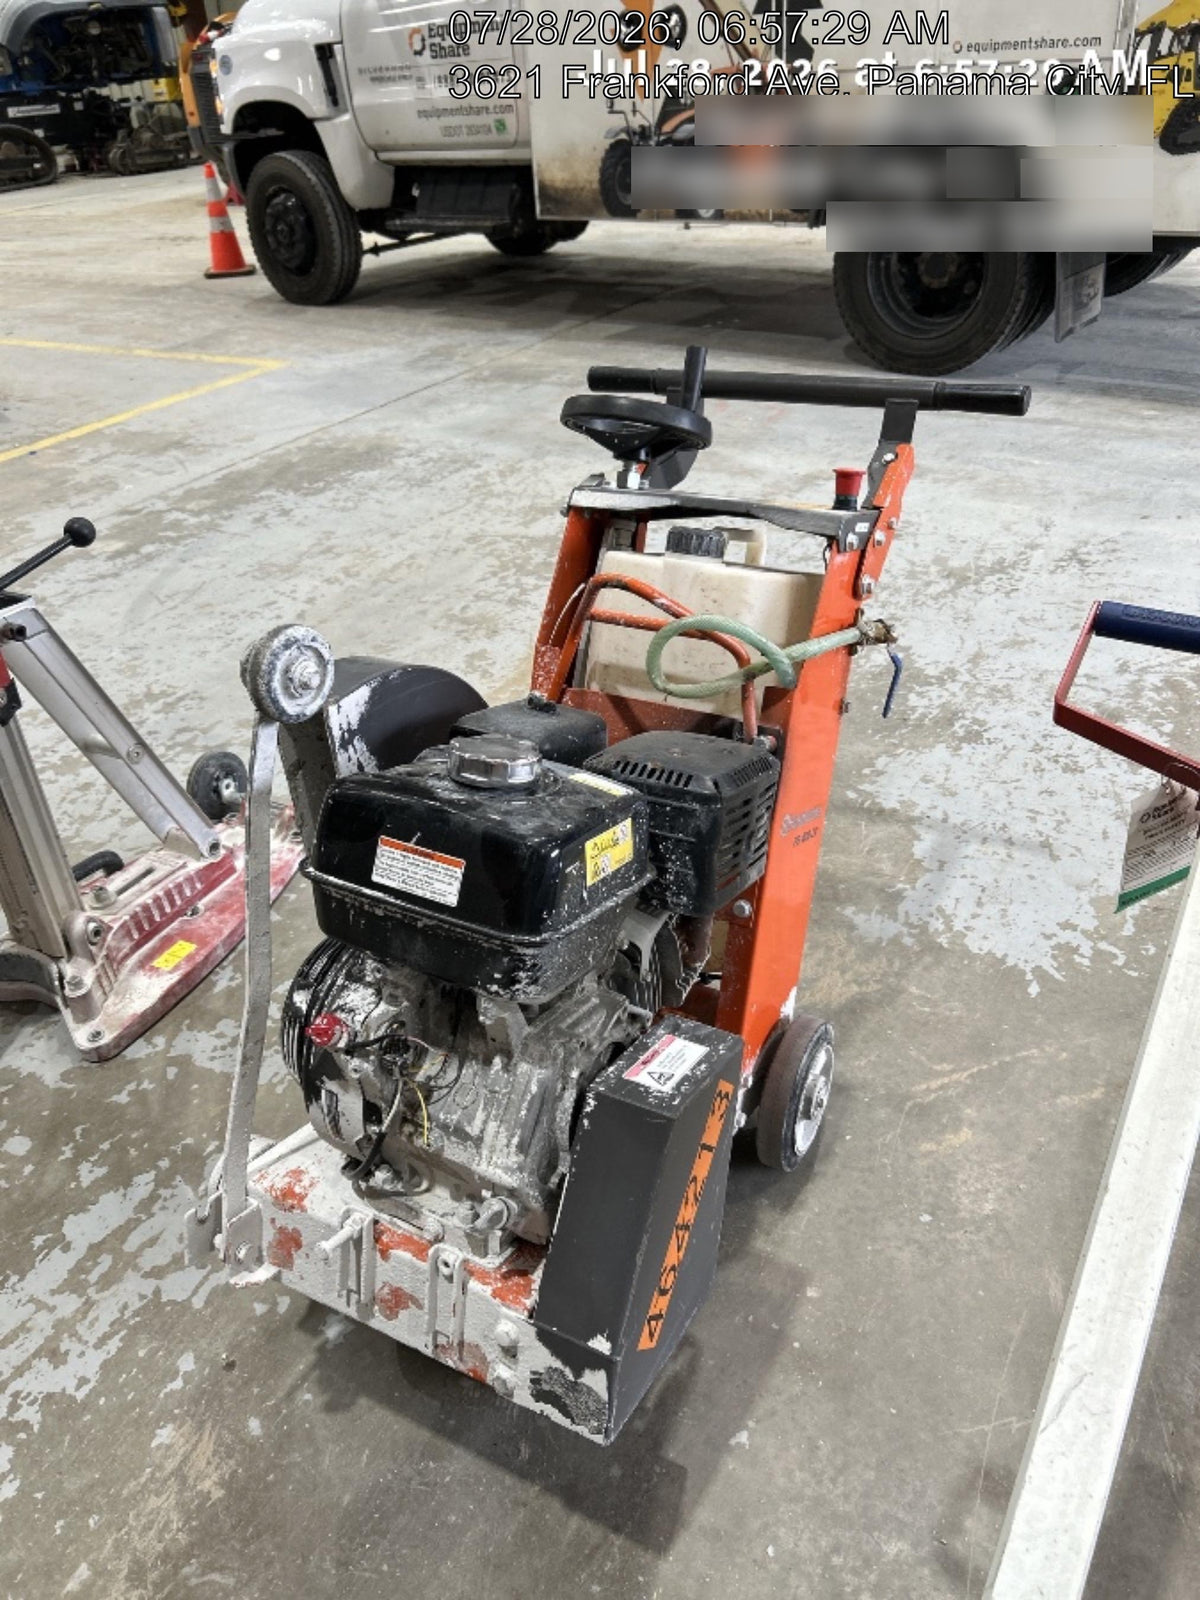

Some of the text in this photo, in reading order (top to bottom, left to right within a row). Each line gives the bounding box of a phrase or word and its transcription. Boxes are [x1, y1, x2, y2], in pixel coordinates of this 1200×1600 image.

[429, 42, 470, 59] Share
[966, 35, 1102, 54] equipmentshare.com
[417, 103, 515, 121] equipmentshare.com
